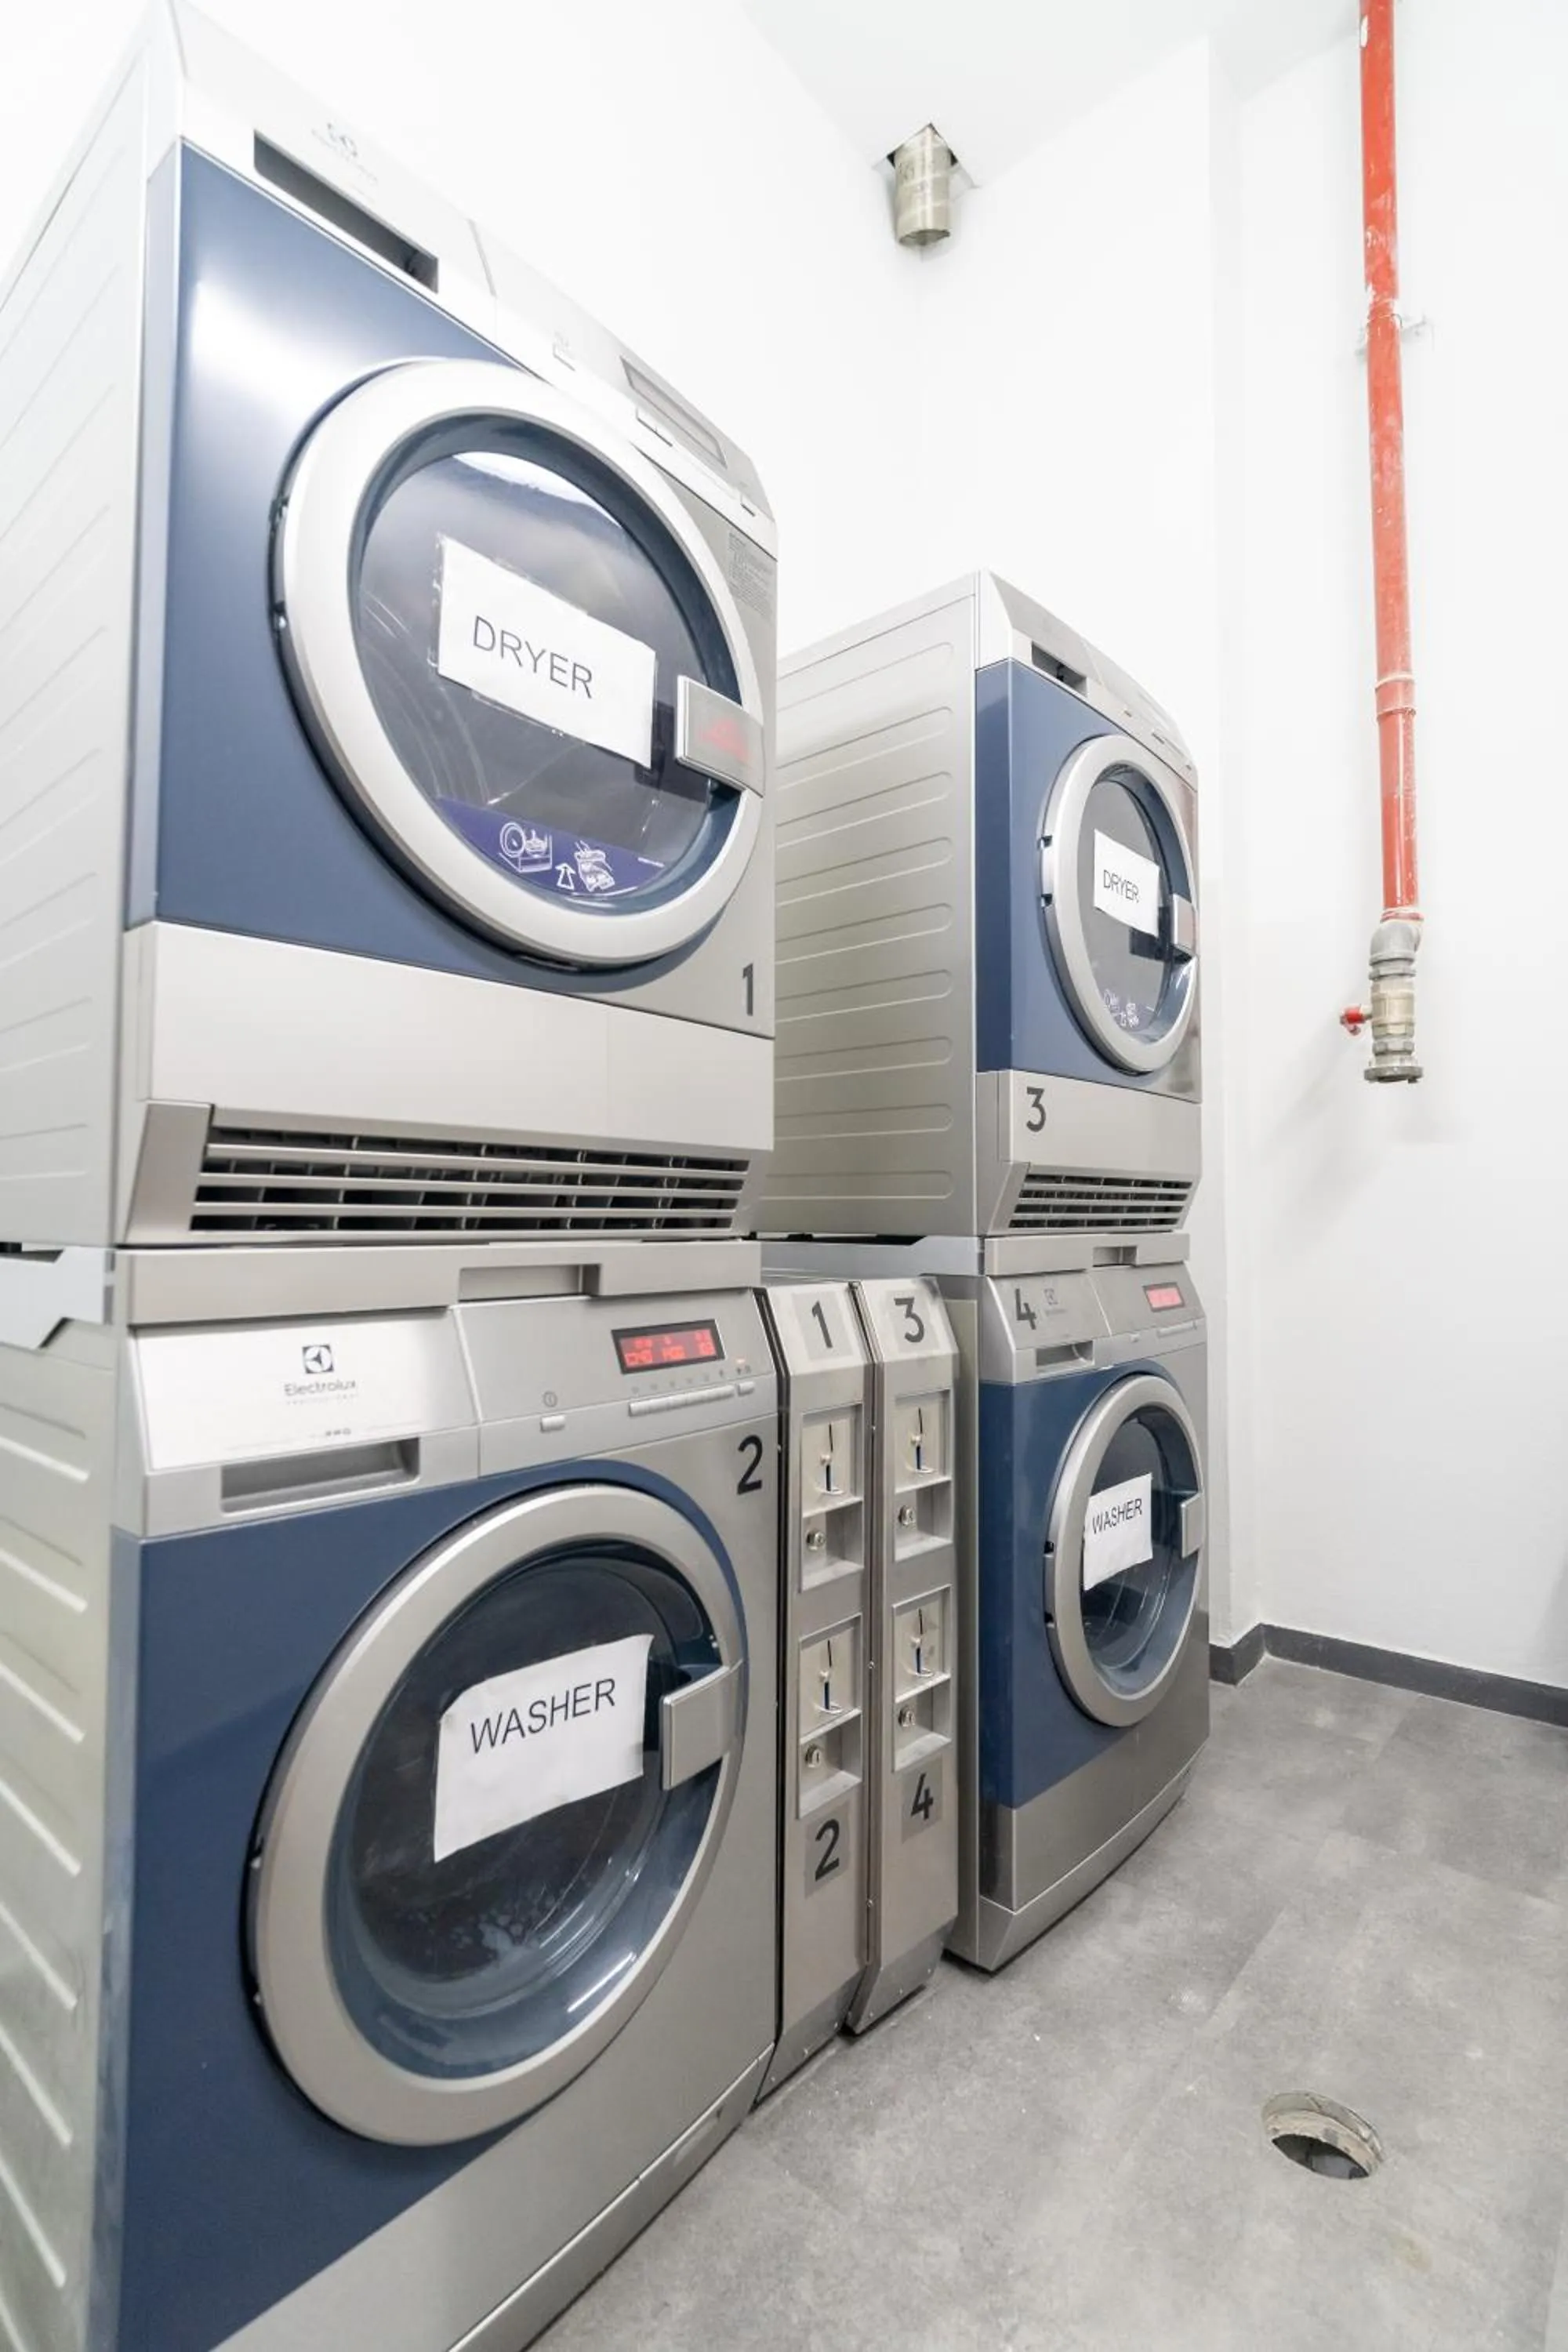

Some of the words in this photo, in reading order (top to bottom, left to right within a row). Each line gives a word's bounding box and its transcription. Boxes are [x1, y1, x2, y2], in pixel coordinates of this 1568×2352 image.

[472, 615, 593, 699] DRYER
[1103, 869, 1139, 903] DRYER
[742, 963, 754, 1017] 1
[1025, 1086, 1047, 1133] 3
[811, 1301, 833, 1349] 1
[893, 1297, 925, 1343] 3
[1014, 1288, 1037, 1330] 4
[283, 1379, 356, 1396] Electrolux
[737, 1434, 763, 1494] 2
[1092, 1497, 1143, 1535] WASHER
[470, 1678, 616, 1754] WASHER
[910, 1773, 934, 1820] 4
[815, 1818, 840, 1882] 2
